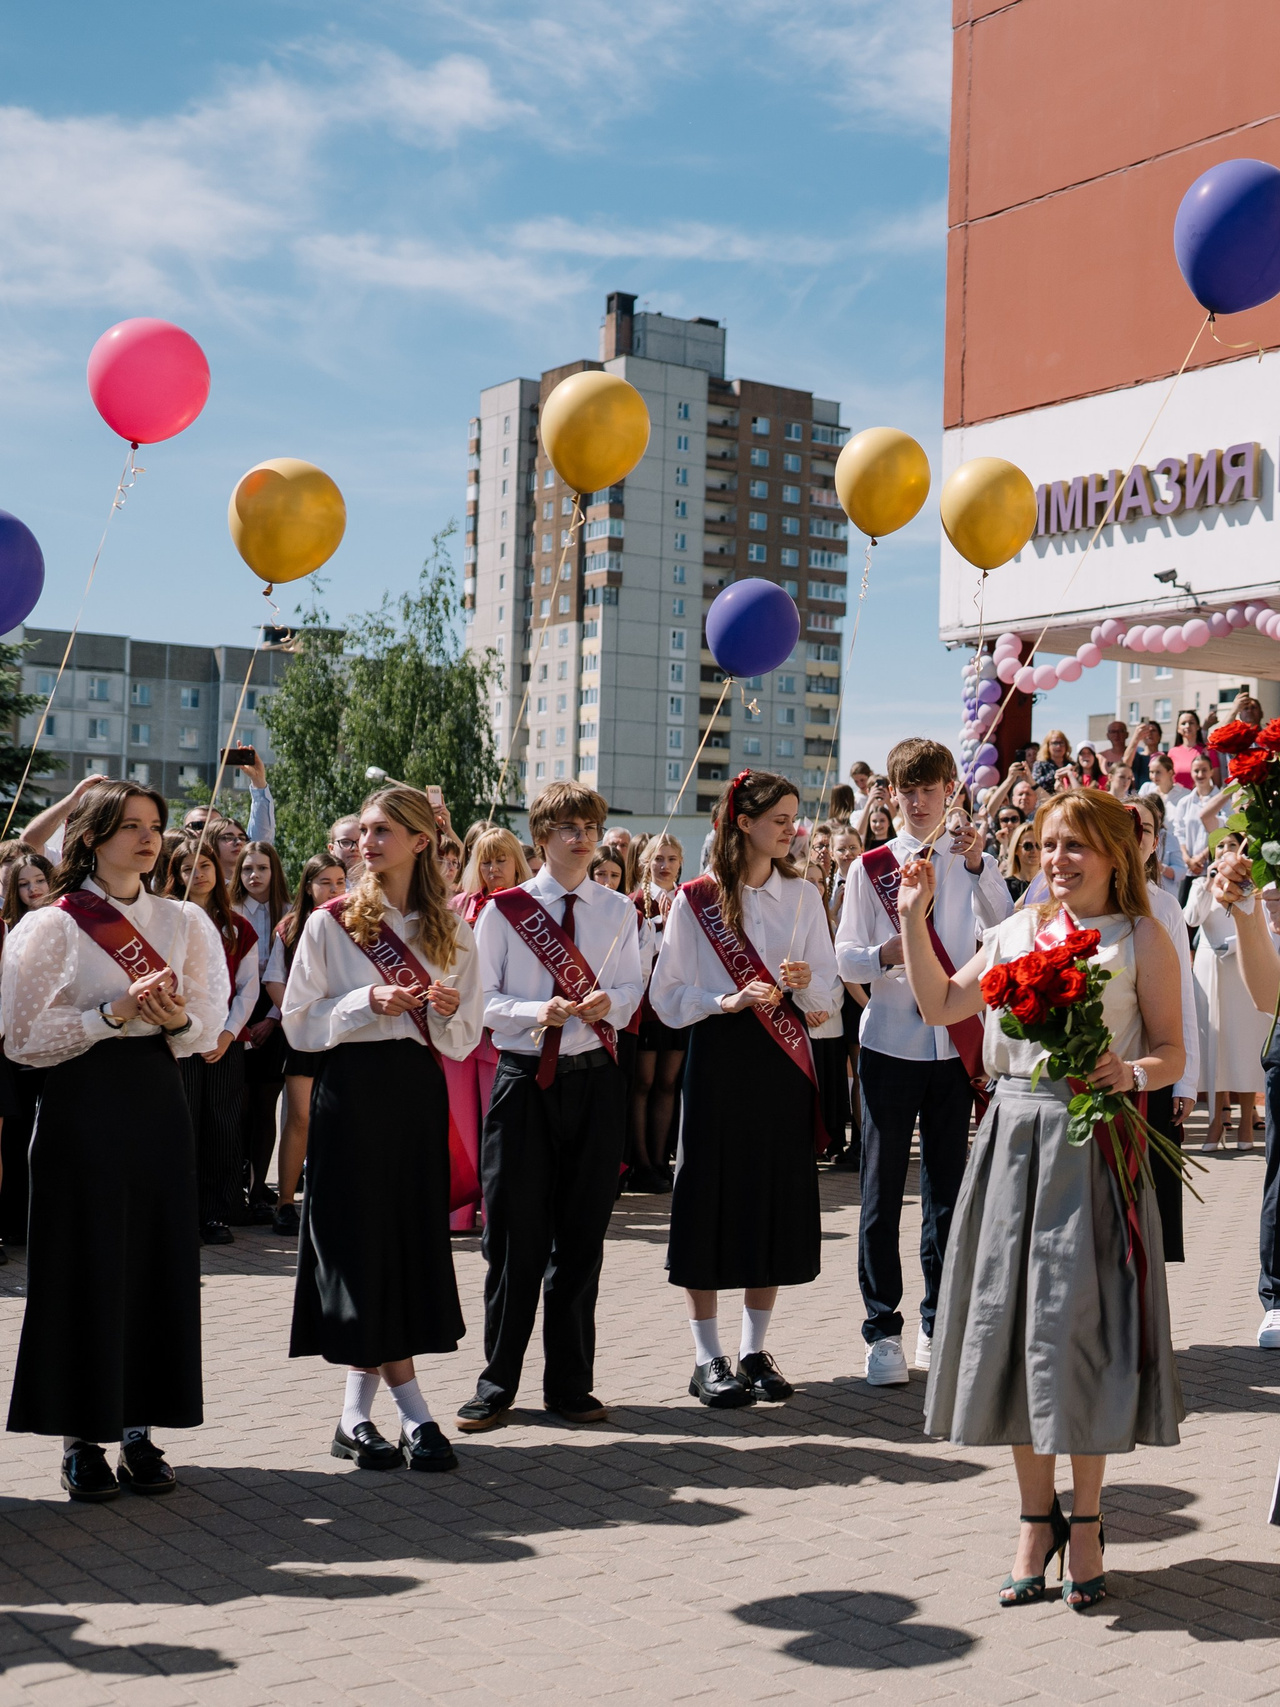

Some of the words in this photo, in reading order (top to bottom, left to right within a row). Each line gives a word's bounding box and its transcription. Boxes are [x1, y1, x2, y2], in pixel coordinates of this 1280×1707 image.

[116, 936, 158, 975] ВЫ
[374, 956, 397, 985] ГИМНАЗИ
[543, 959, 567, 986] ГИМНАЗИЯ
[773, 1011, 803, 1050] 2024
